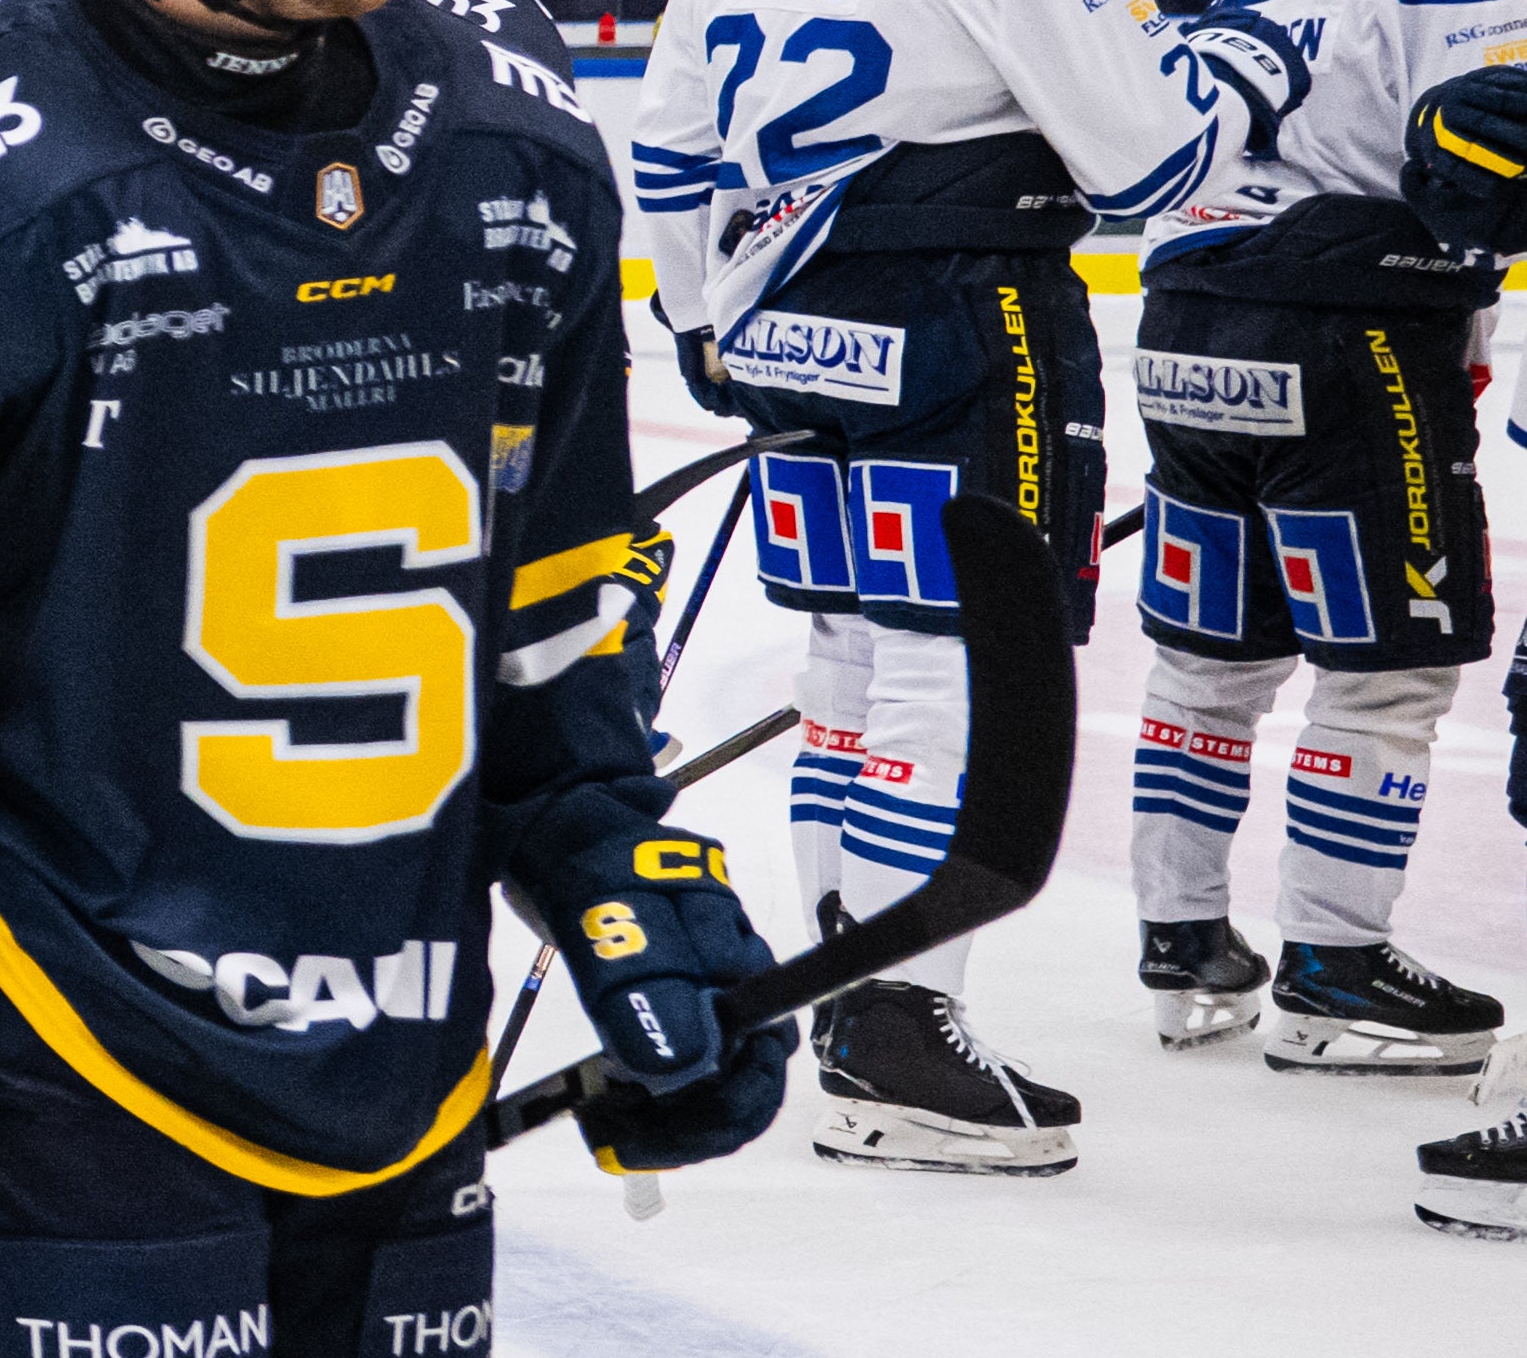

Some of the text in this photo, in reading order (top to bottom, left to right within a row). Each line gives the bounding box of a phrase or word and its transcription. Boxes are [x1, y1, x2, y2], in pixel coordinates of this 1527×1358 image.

[296, 272, 397, 303] CCM
[230, 351, 461, 399] SILJENDAHLS
[997, 286, 1041, 526] JORDKULLEN
[1365, 328, 1433, 551] JORDKULLEN
[182, 440, 484, 846] S
[581, 901, 648, 961] S
[628, 991, 676, 1060] CCM
